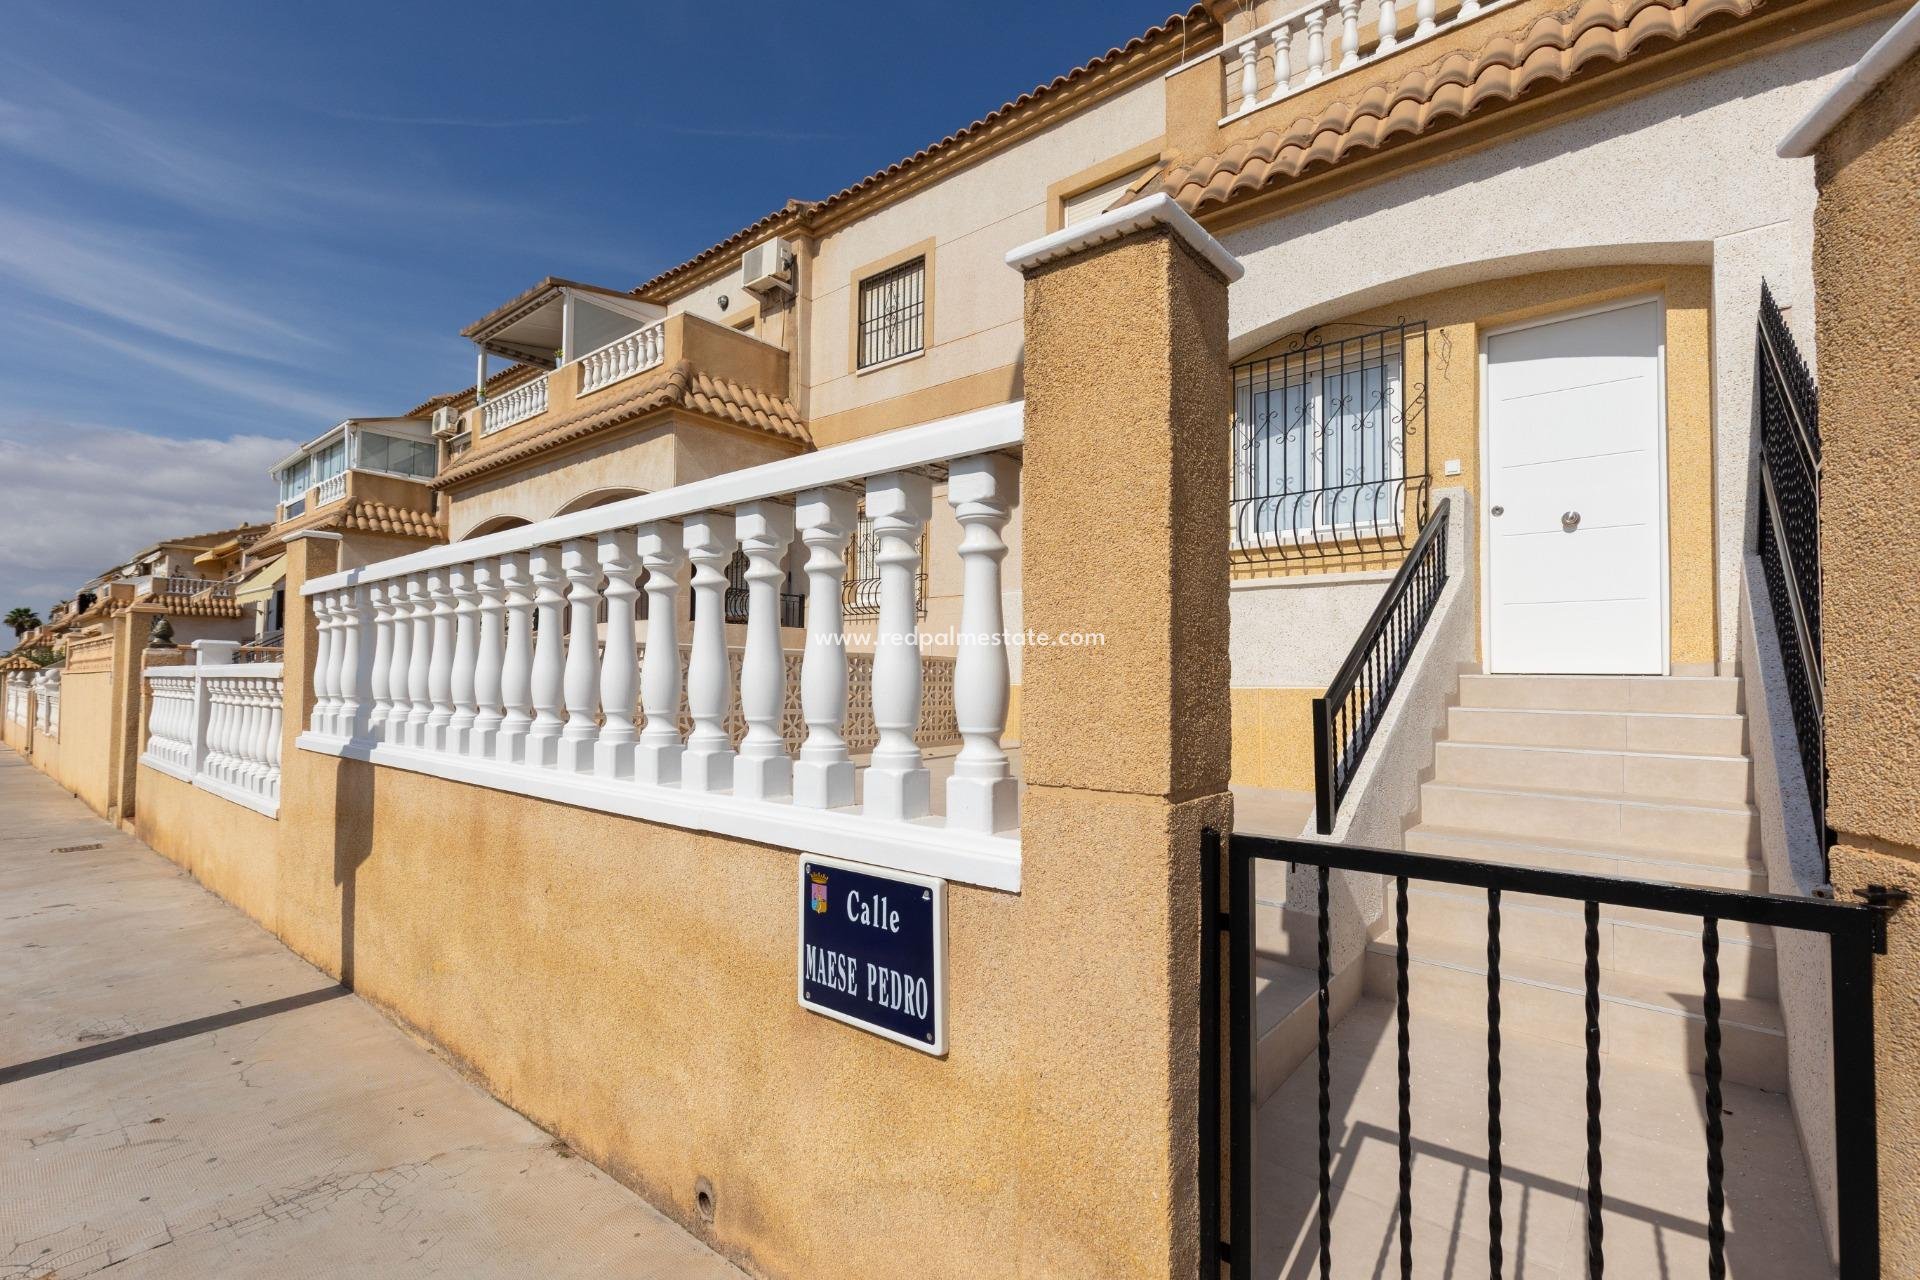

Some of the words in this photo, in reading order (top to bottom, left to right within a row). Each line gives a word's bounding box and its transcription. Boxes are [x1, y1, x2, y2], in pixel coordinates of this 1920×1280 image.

[847, 890, 900, 933] Calle
[805, 943, 858, 996] MAESE
[867, 963, 928, 1020] PEDRO
